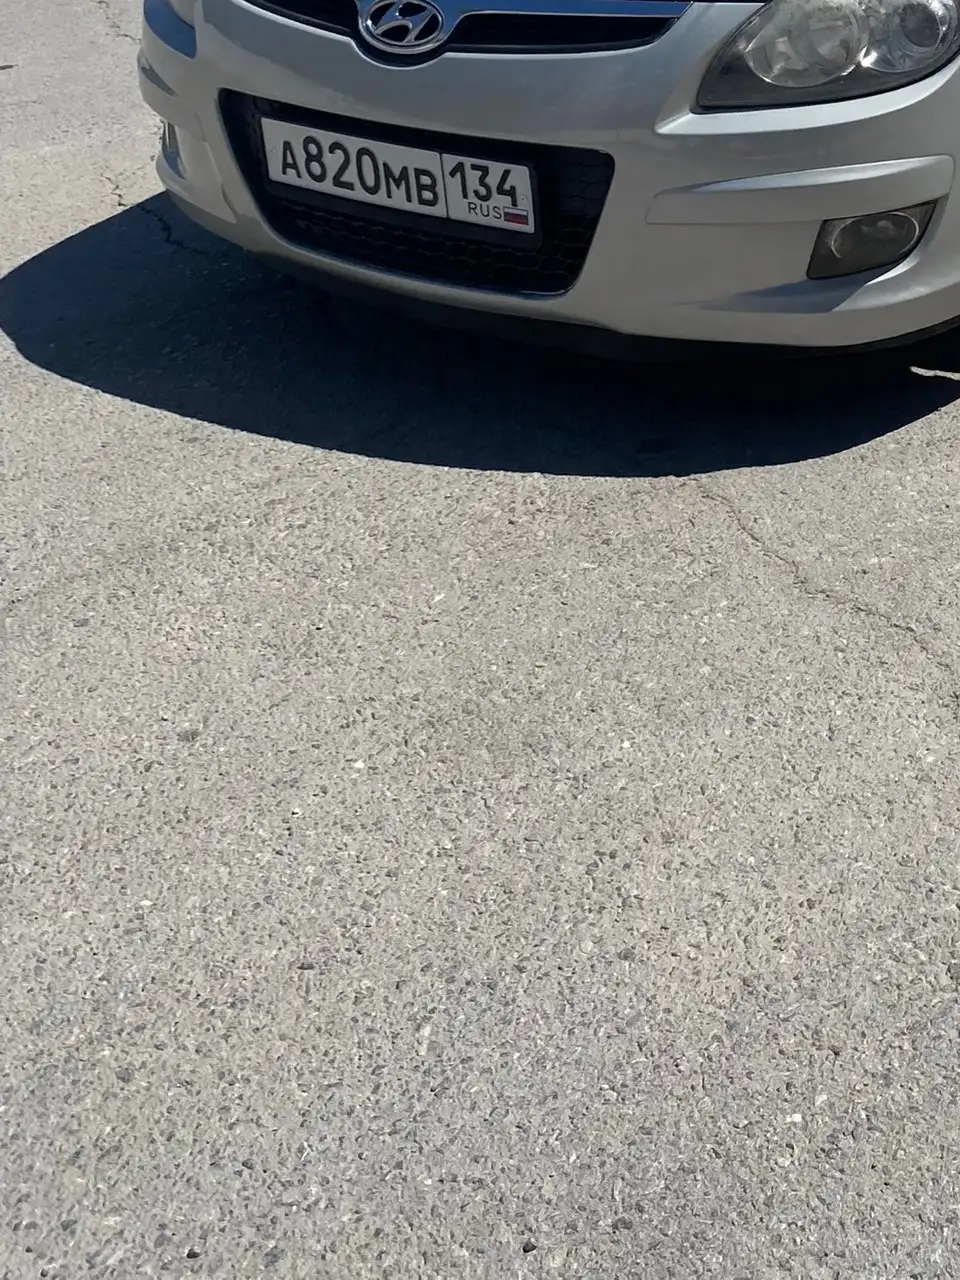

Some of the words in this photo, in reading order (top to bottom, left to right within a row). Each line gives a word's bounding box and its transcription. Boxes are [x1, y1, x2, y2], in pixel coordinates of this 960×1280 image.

[281, 135, 439, 207] А820МВ
[449, 161, 518, 208] 134
[467, 202, 502, 220] RUS
